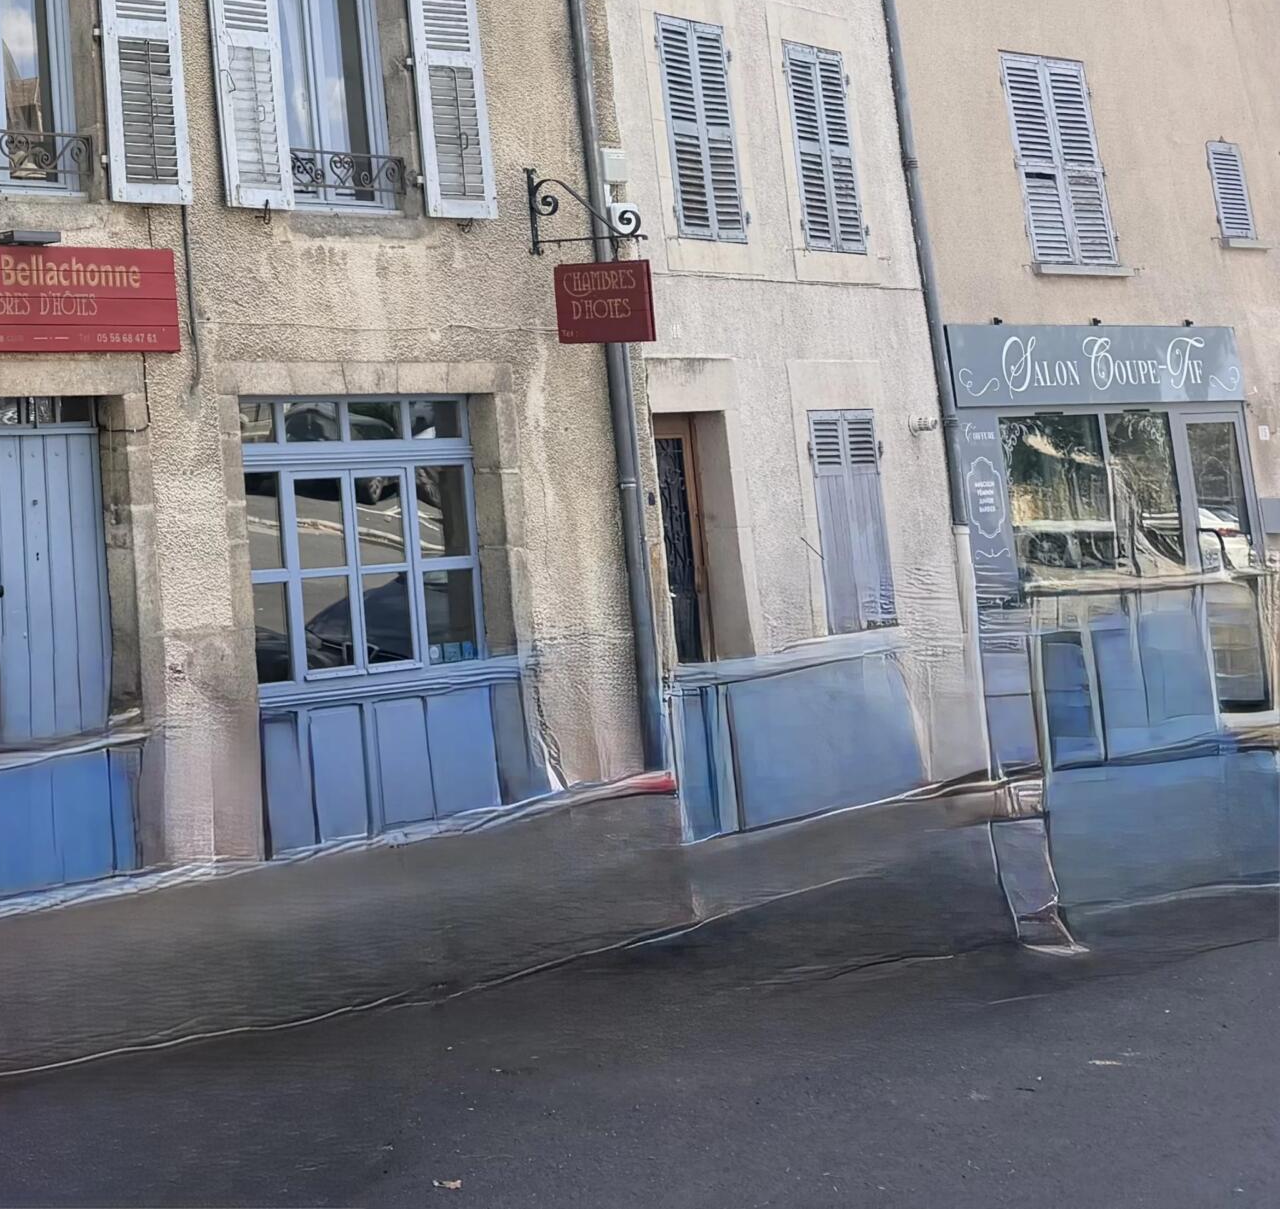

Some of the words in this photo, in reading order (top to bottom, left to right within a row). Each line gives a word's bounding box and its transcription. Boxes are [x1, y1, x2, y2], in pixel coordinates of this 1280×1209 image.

[0, 254, 142, 288] Bellachonne
[563, 269, 637, 297] CHAMBRES
[96, 333, 107, 343] 05
[134, 333, 145, 343] 47
